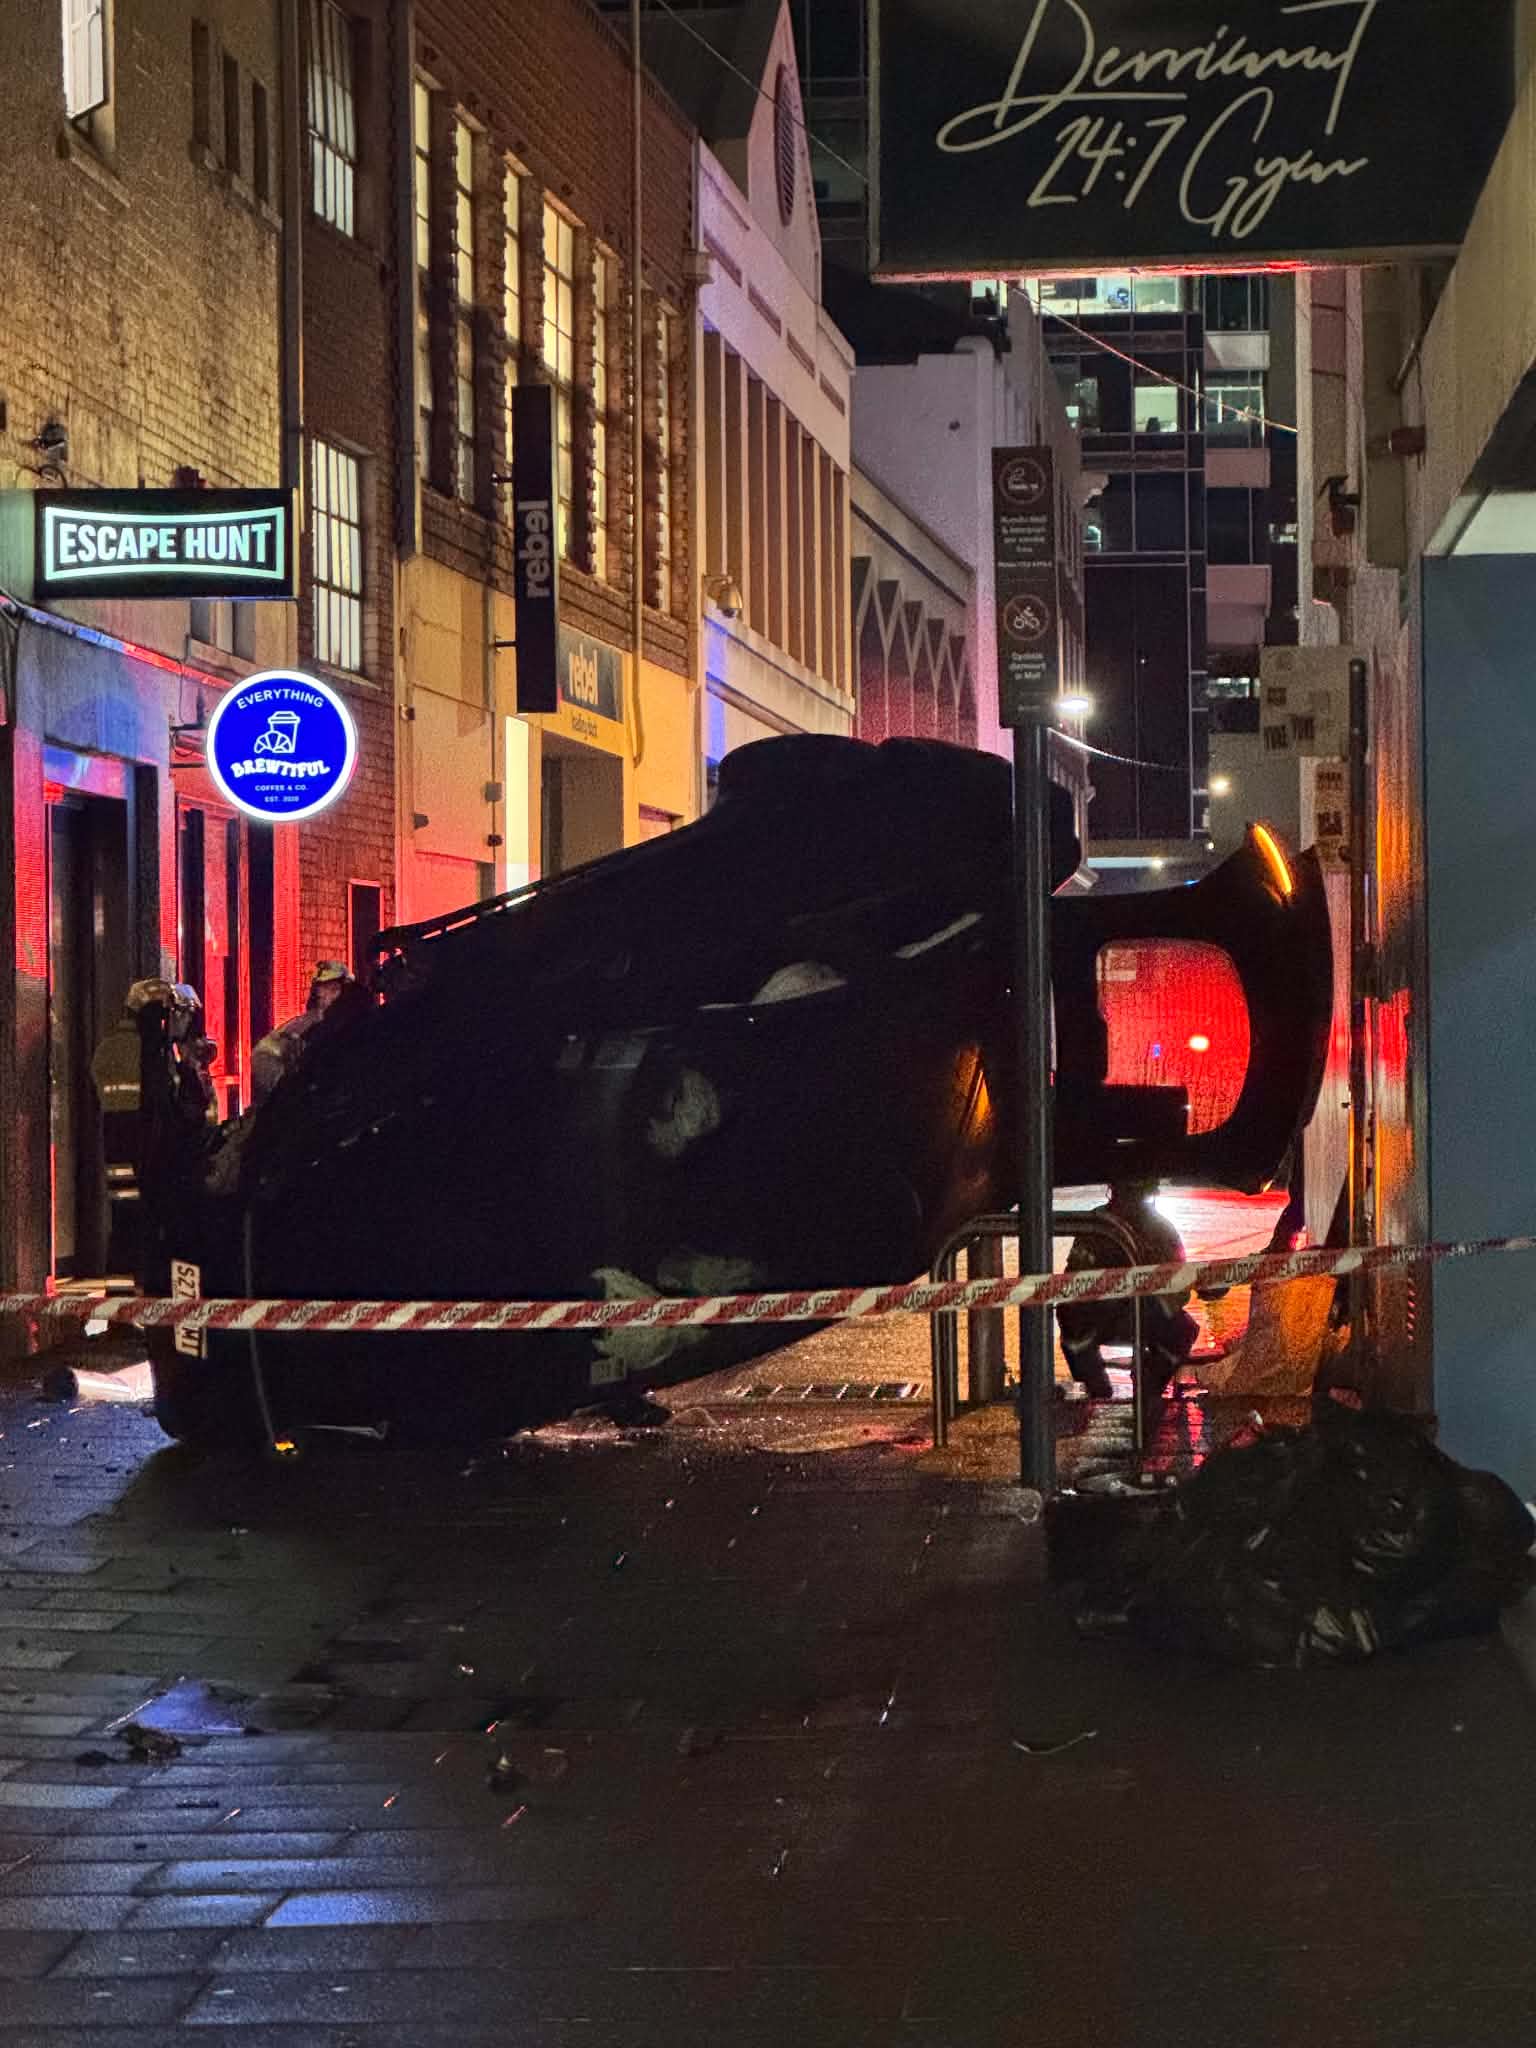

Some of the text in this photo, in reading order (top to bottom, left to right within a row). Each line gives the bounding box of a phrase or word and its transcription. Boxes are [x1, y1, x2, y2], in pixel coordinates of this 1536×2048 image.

[1027, 86, 1369, 239] 24:7 Gym
[59, 522, 272, 564] ESCAPE HUNT
[517, 499, 549, 599] rebel
[568, 643, 599, 705] rebel
[236, 688, 324, 710] EVERYTHING
[230, 758, 331, 778] BREWTIFUL
[255, 784, 285, 792] COFFEE
